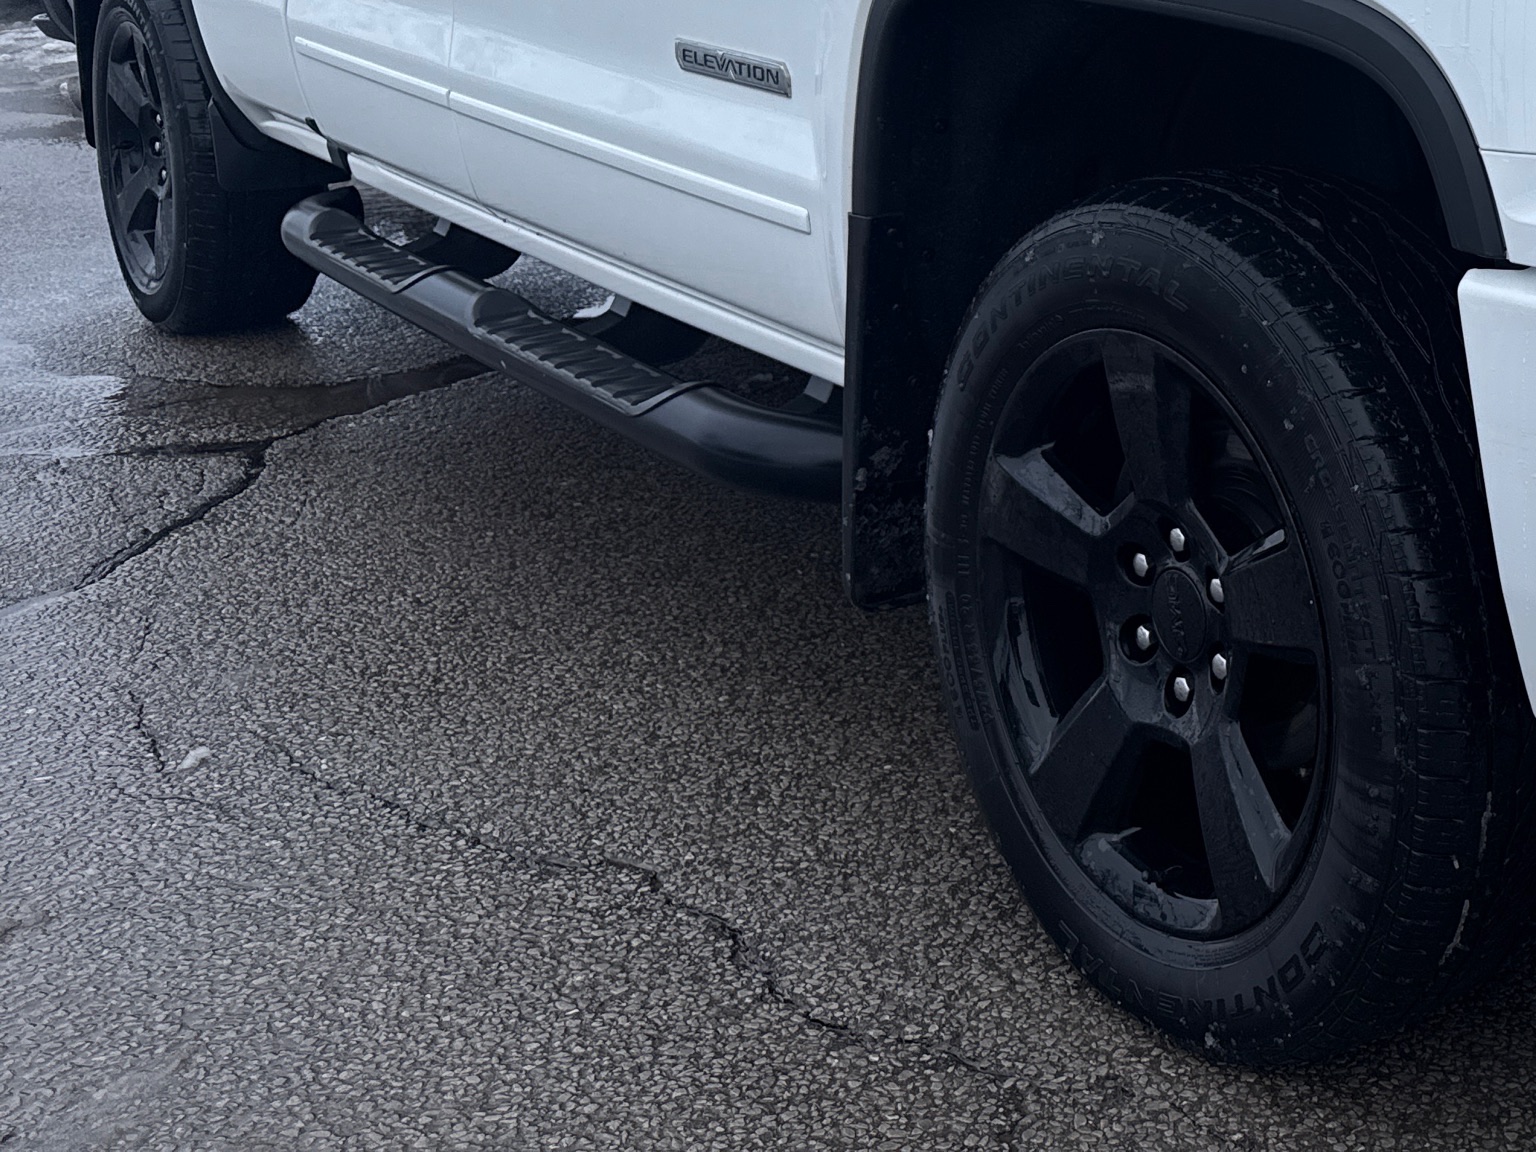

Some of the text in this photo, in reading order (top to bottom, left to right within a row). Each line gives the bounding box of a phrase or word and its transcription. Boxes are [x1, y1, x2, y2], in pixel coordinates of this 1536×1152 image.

[682, 47, 780, 86] ELEVATION
[956, 253, 1190, 392] CONTINENTAL
[1057, 919, 1326, 1019] CONTINENTAL
